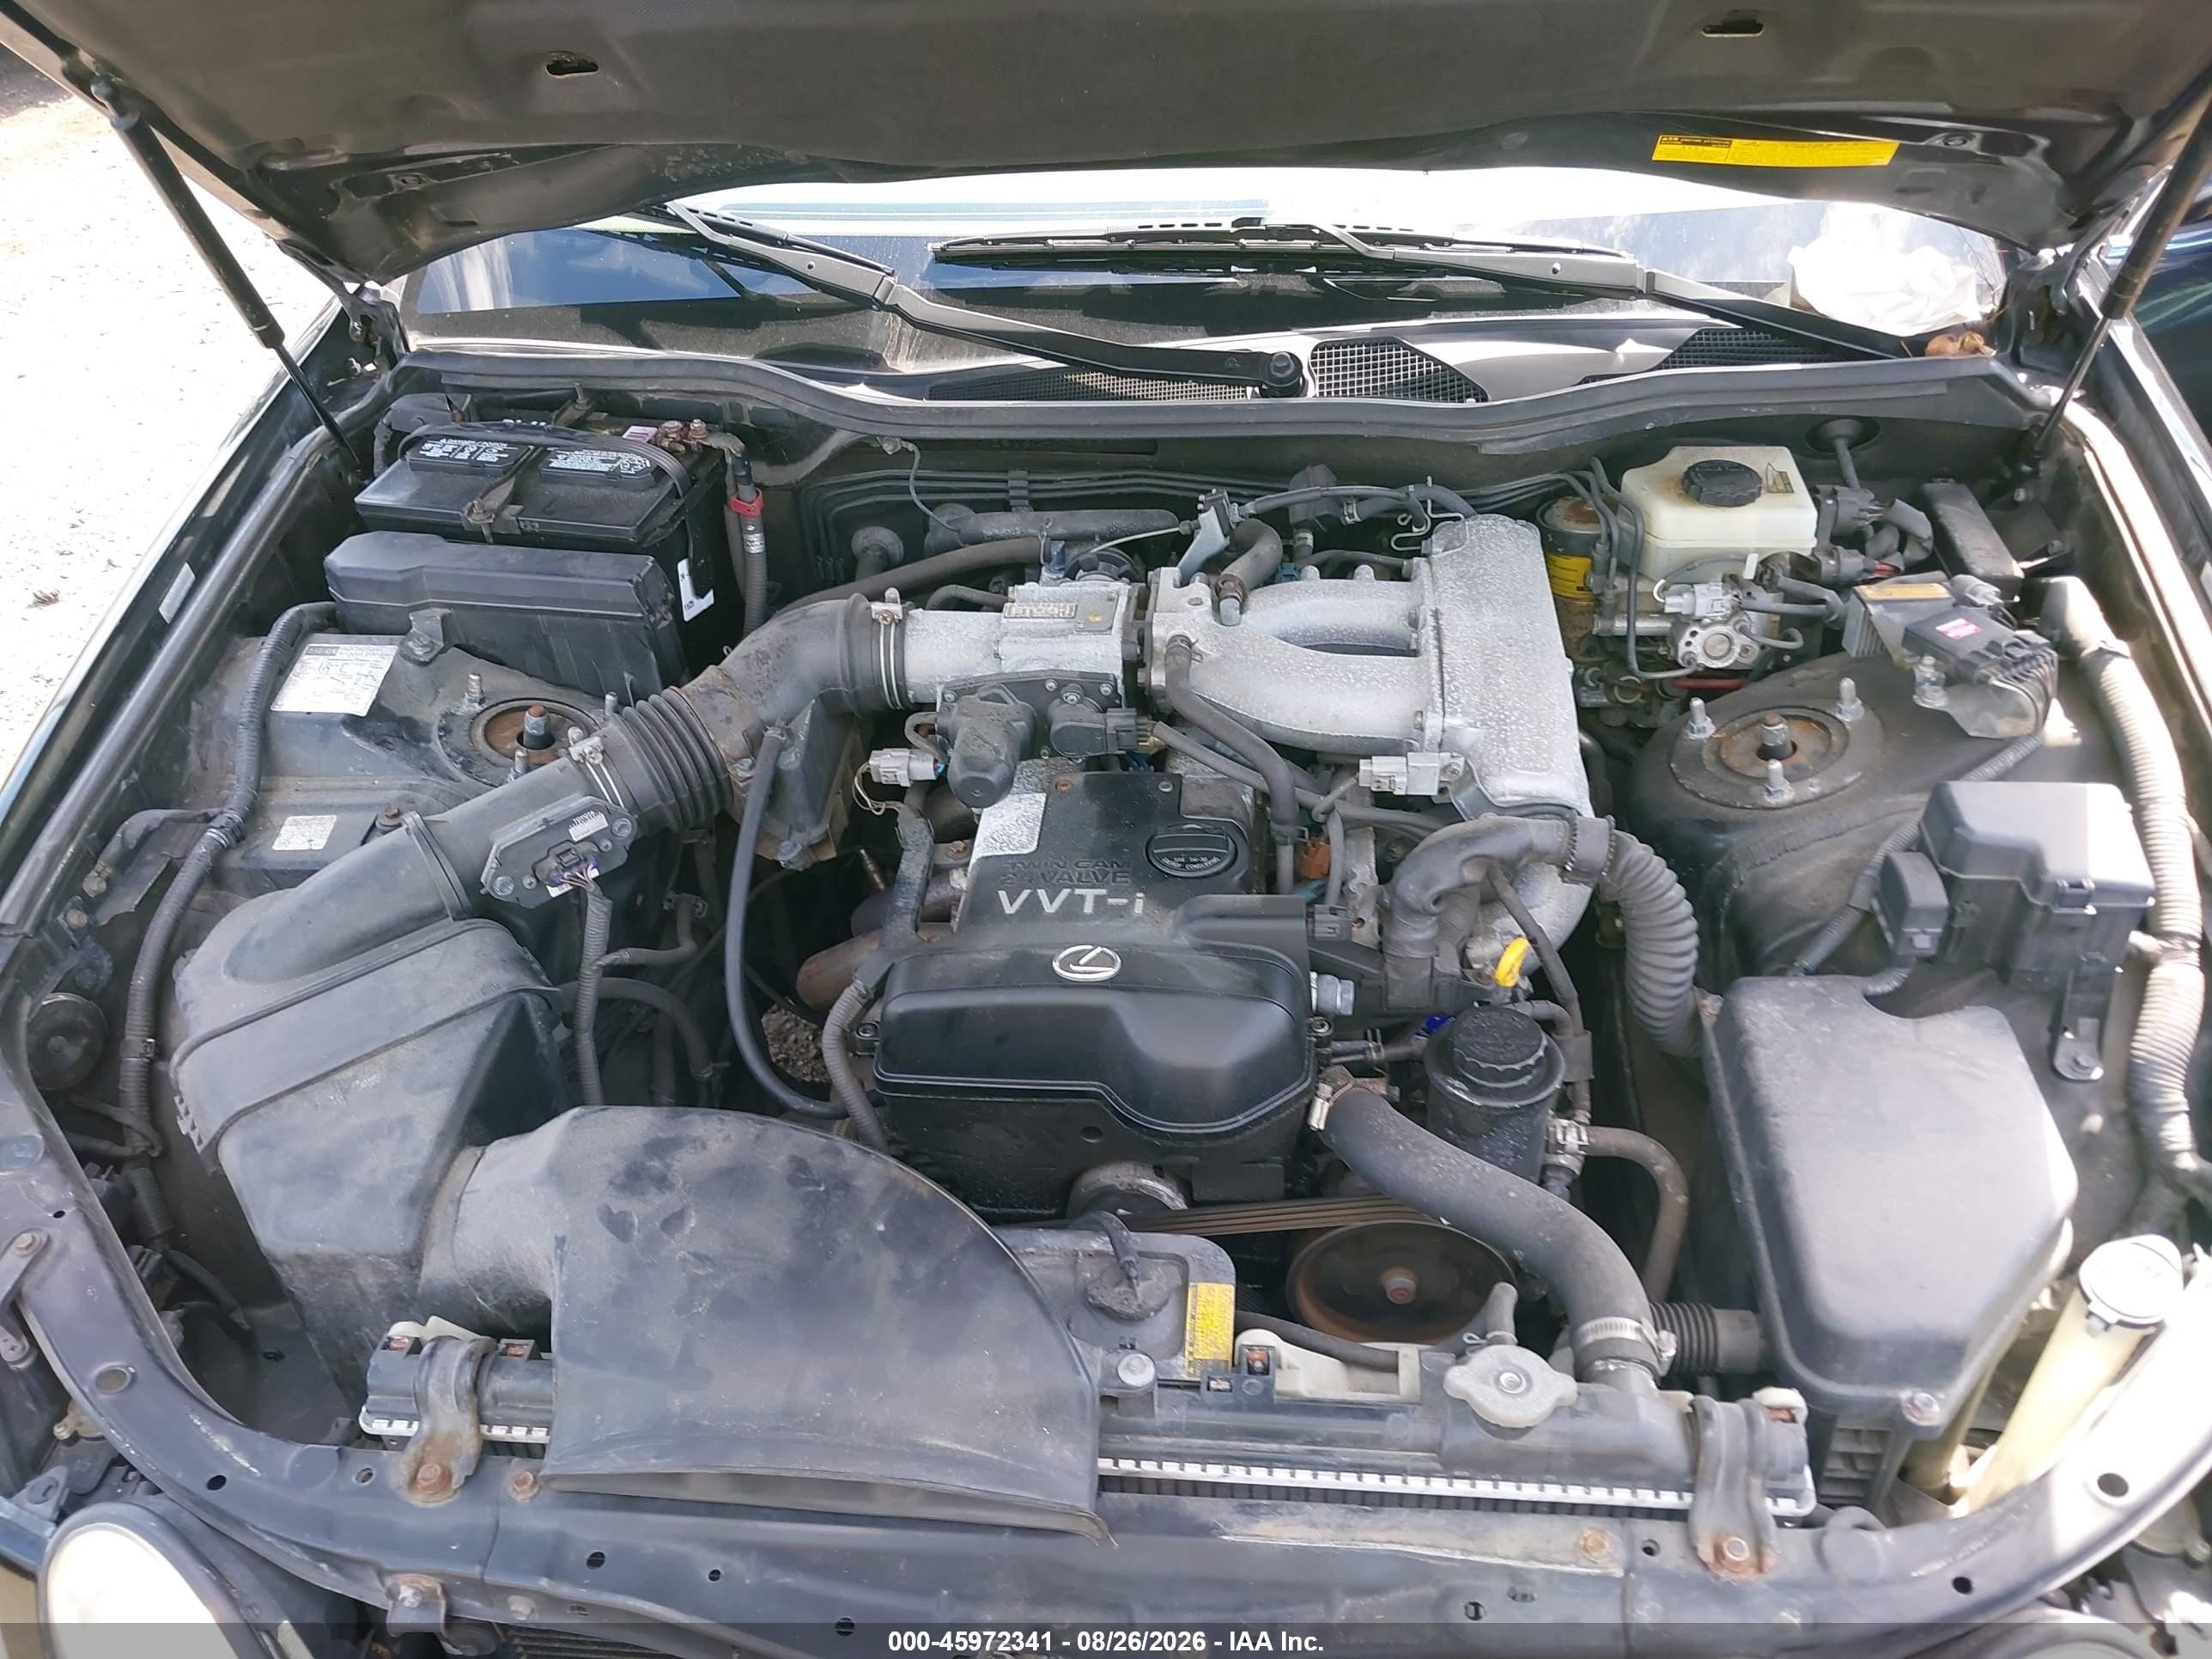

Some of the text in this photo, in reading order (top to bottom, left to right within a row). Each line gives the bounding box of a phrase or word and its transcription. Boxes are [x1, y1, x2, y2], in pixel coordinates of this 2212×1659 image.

[1006, 856, 1132, 870] TWIN CAM
[1038, 871, 1132, 886] VALVE
[997, 888, 1145, 915] VVT-i
